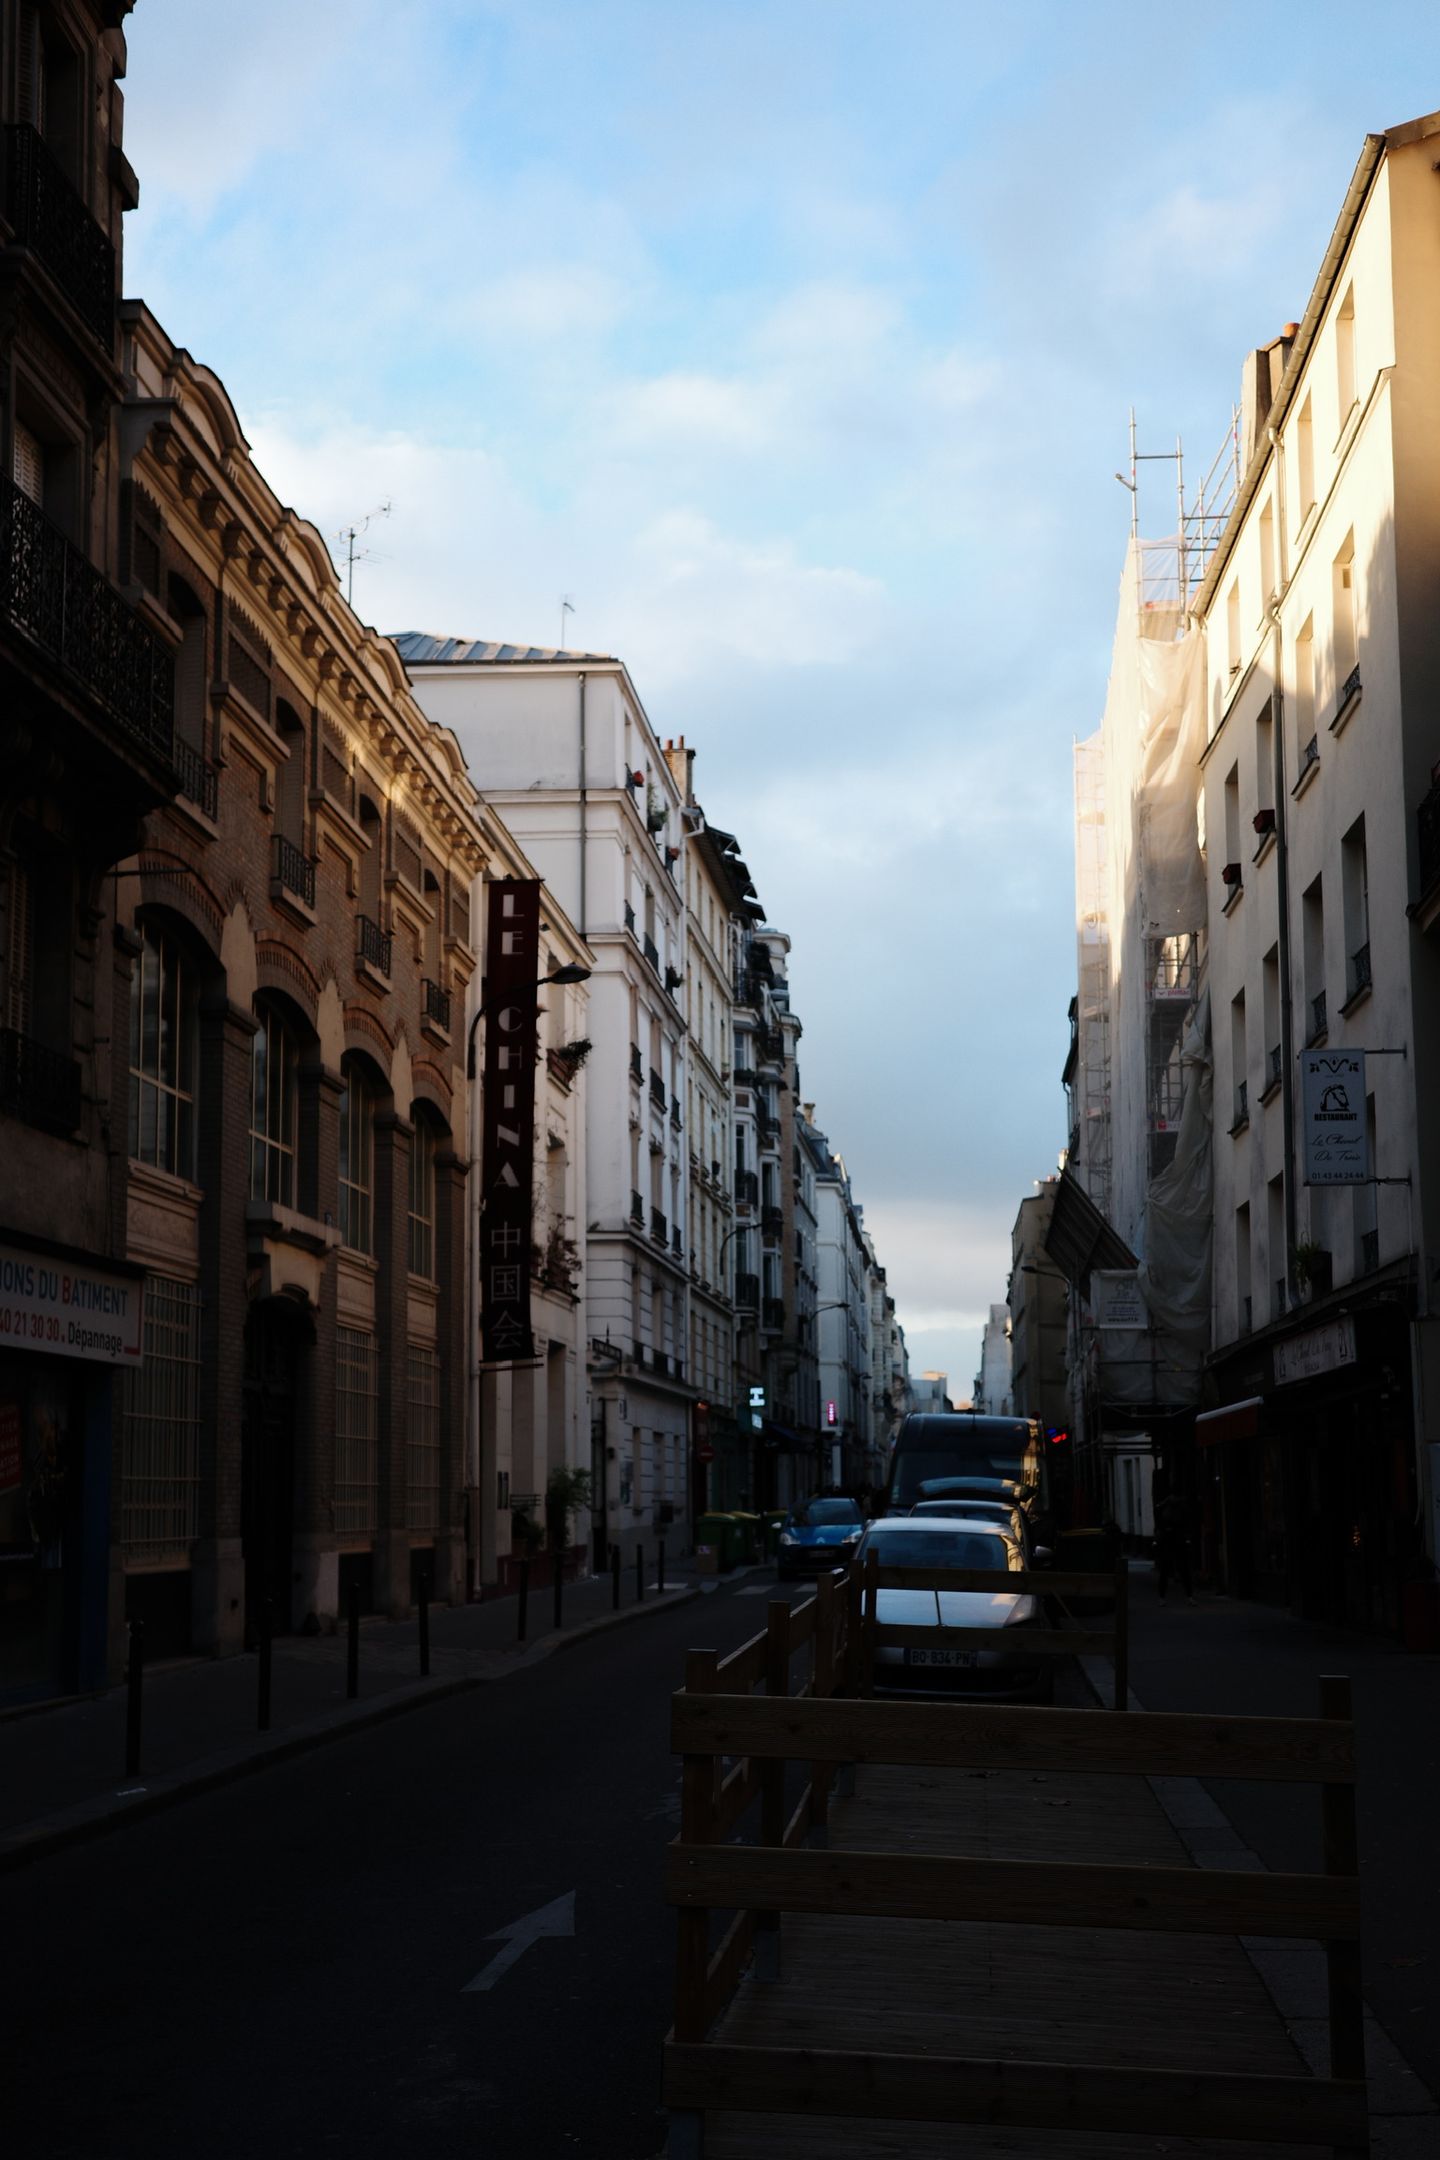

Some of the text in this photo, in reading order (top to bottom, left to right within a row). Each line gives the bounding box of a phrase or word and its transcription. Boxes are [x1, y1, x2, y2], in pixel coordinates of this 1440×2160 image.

[501, 893, 525, 955] LE
[493, 1006, 526, 1188] CHINA
[39, 1270, 58, 1301] DU
[62, 1275, 128, 1316] BATIMENT
[14, 1310, 27, 1336] 21
[30, 1313, 44, 1338] 30
[68, 1319, 122, 1356] Dépannage
